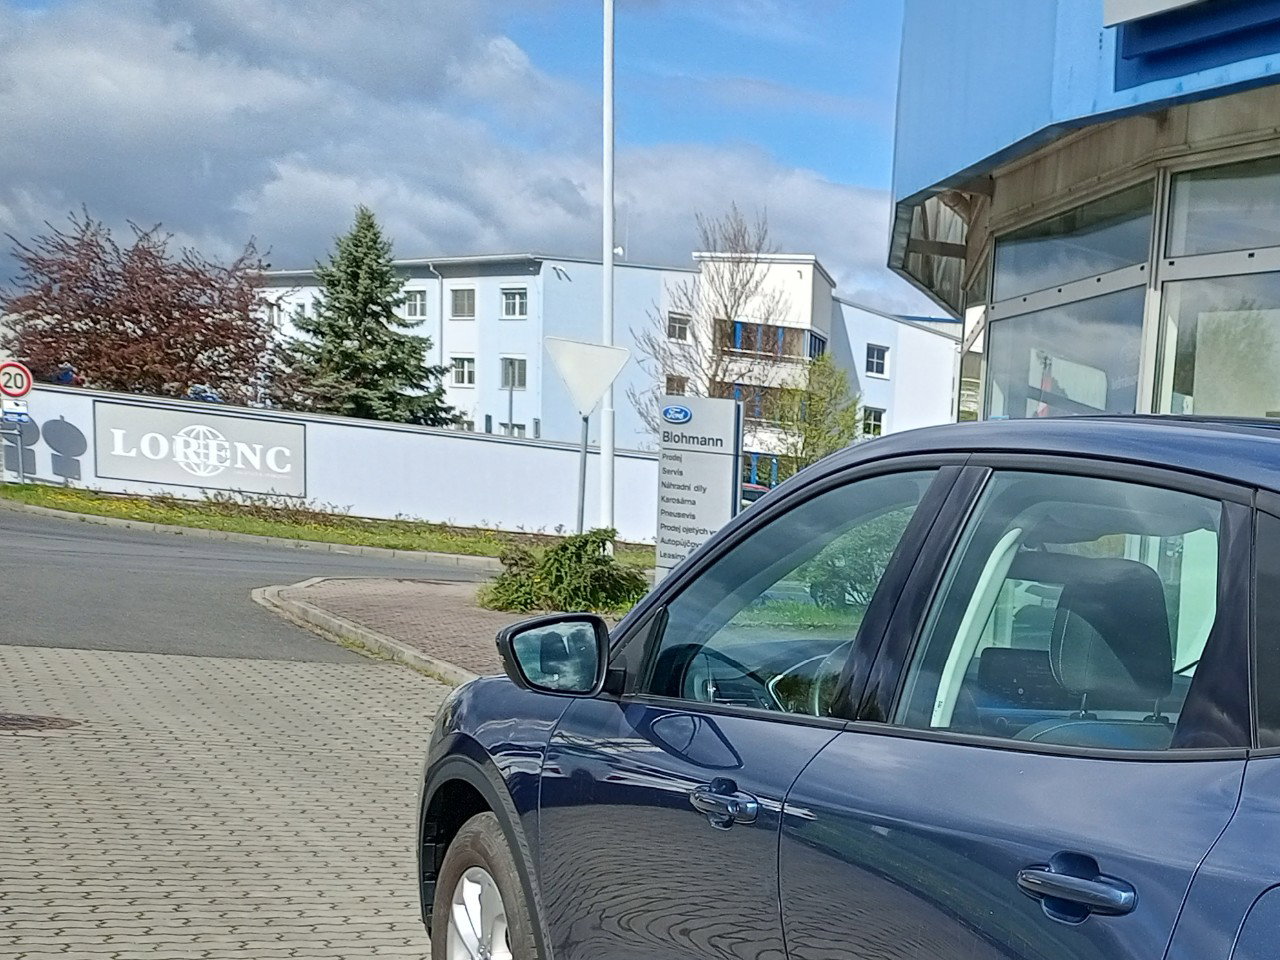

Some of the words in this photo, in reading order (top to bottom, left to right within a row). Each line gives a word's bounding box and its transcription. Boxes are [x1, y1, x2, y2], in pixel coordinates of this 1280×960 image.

[2, 371, 24, 389] 20
[662, 431, 723, 448] Blohmann
[110, 428, 292, 474] LORENC
[662, 453, 682, 463] Prodej
[662, 467, 683, 476] Servis
[660, 522, 681, 533] Prodej
